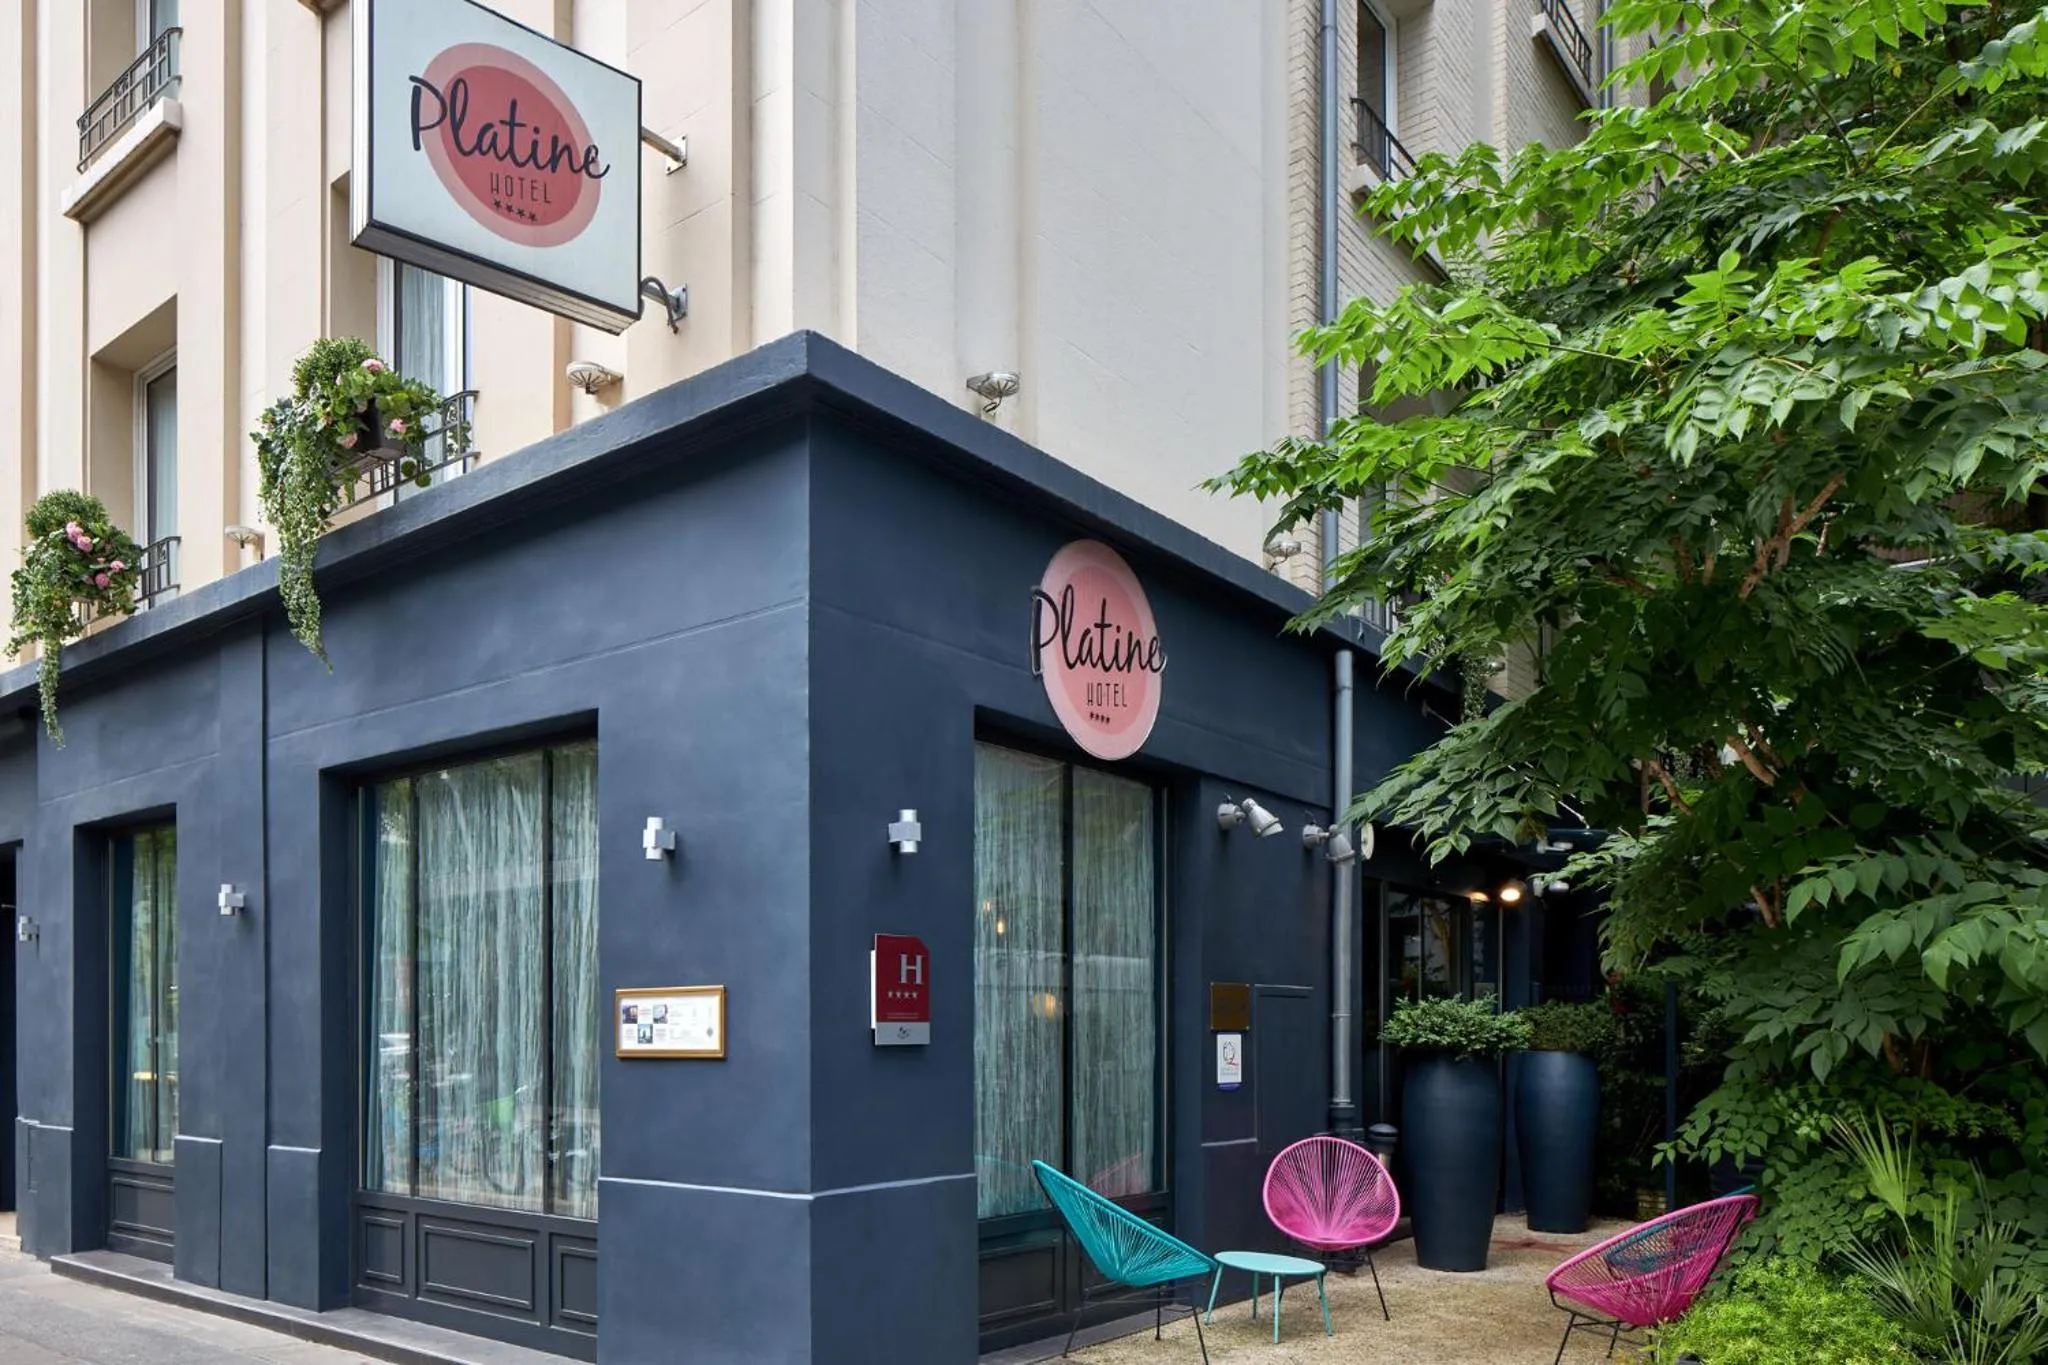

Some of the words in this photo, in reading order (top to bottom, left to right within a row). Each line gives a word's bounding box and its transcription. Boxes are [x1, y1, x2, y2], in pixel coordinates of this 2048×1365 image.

[409, 75, 610, 180] Platine
[490, 172, 552, 204] HOTEL
[1030, 583, 1167, 674] Platine
[1087, 682, 1127, 708] HOTEL
[900, 954, 923, 984] H
